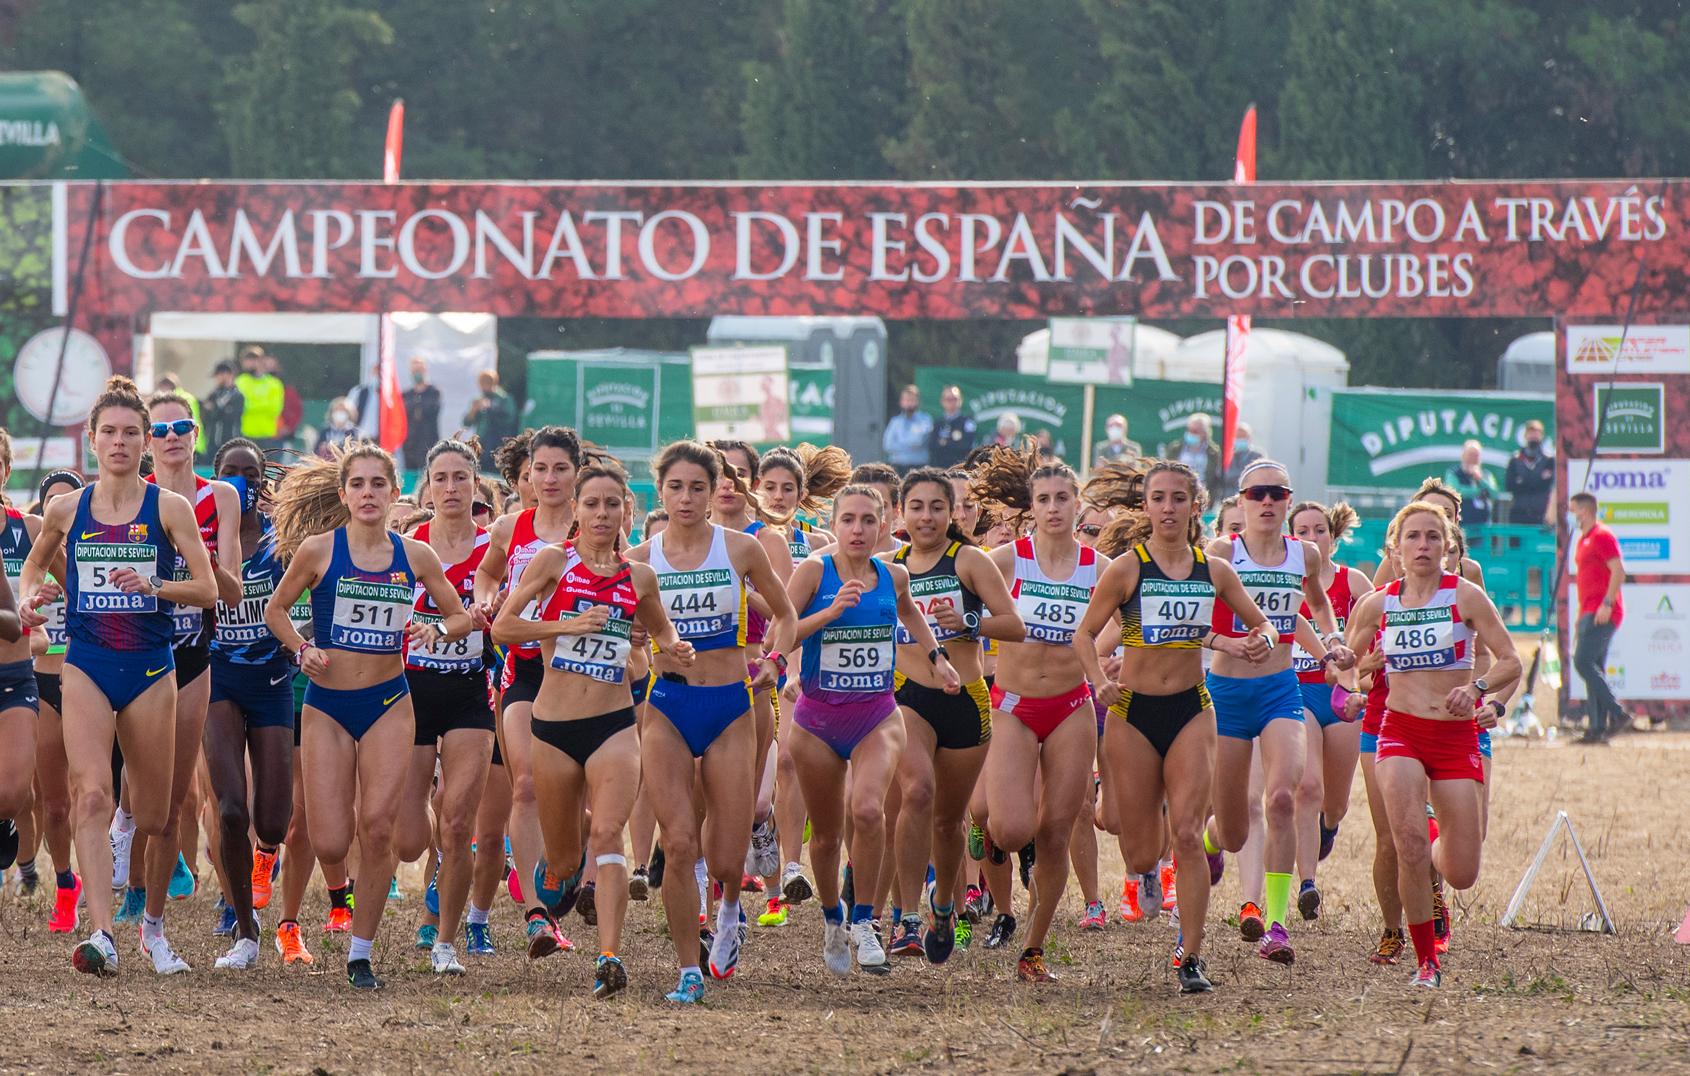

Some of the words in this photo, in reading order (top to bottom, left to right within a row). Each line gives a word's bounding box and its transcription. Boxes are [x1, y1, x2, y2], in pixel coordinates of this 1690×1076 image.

[1194, 200, 1256, 244] DE
[1266, 199, 1445, 243] CAMPO
[1454, 198, 1490, 242] A
[1495, 184, 1667, 242] TRAVÉS
[108, 208, 710, 280] CAMPEONATO
[729, 211, 844, 281] DE
[866, 195, 1182, 283] ESPAÑA
[1194, 253, 1296, 299] POR
[1300, 252, 1474, 298] CLUBES
[77, 547, 117, 557] DIPUTACION
[118, 548, 127, 557] DE
[128, 548, 155, 558] SEVILLA
[695, 573, 704, 584] DE
[704, 571, 731, 582] SEVILLA
[925, 581, 934, 591] DE
[935, 577, 960, 589] SEVILLA
[1276, 574, 1284, 584] DE
[248, 582, 272, 595] SEVILLA
[339, 583, 379, 597] DIPUTACION
[380, 587, 390, 598] DE
[1022, 582, 1060, 597] DIPUTACION
[1061, 587, 1069, 597] DE
[1070, 589, 1090, 600] SEVILLA
[1142, 582, 1179, 593] DIPUTACION
[1180, 584, 1189, 593] DE
[1190, 584, 1215, 593] SEVILLA
[671, 592, 717, 614] 444
[1158, 601, 1200, 621] 407
[1254, 592, 1291, 611] 461
[350, 604, 393, 627] 511
[1033, 602, 1076, 624] 485
[1418, 611, 1425, 621] DE
[1426, 608, 1450, 620] SEVILLA
[823, 629, 862, 640] DIPUTACION
[863, 628, 871, 638] DE
[872, 627, 892, 638] SEVILLA
[1395, 628, 1437, 649] 486
[572, 636, 617, 660] 475
[838, 647, 880, 668] 569
